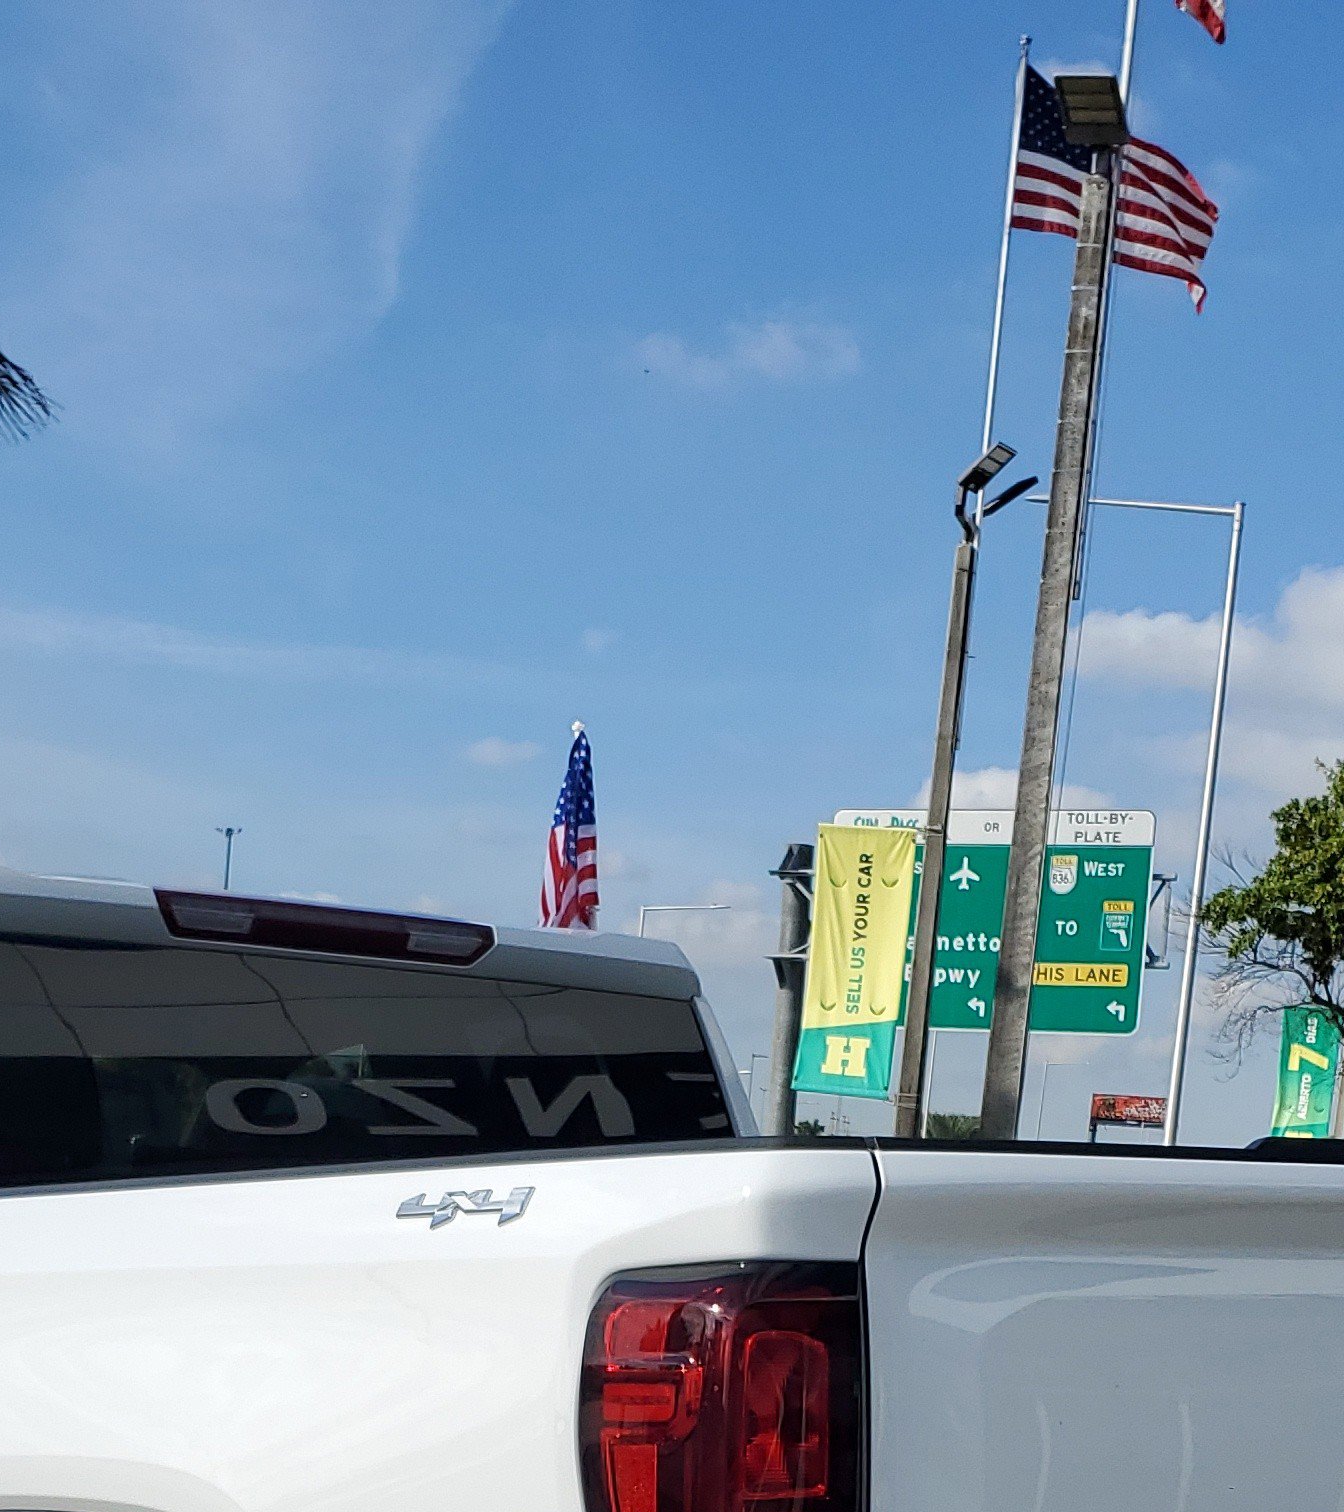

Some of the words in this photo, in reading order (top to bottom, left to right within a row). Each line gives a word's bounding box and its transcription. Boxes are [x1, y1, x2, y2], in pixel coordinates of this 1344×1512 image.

[984, 821, 1001, 833] OR
[1074, 831, 1122, 843] PLATE
[857, 853, 874, 889] CAR
[1083, 860, 1126, 877] WEST
[852, 893, 870, 942] YOUR
[1055, 920, 1078, 936] TO
[849, 946, 866, 970] US
[1035, 966, 1065, 981] HIS
[1075, 968, 1123, 983] LANE
[845, 974, 863, 1015] SELL
[1287, 1043, 1329, 1072] 7
